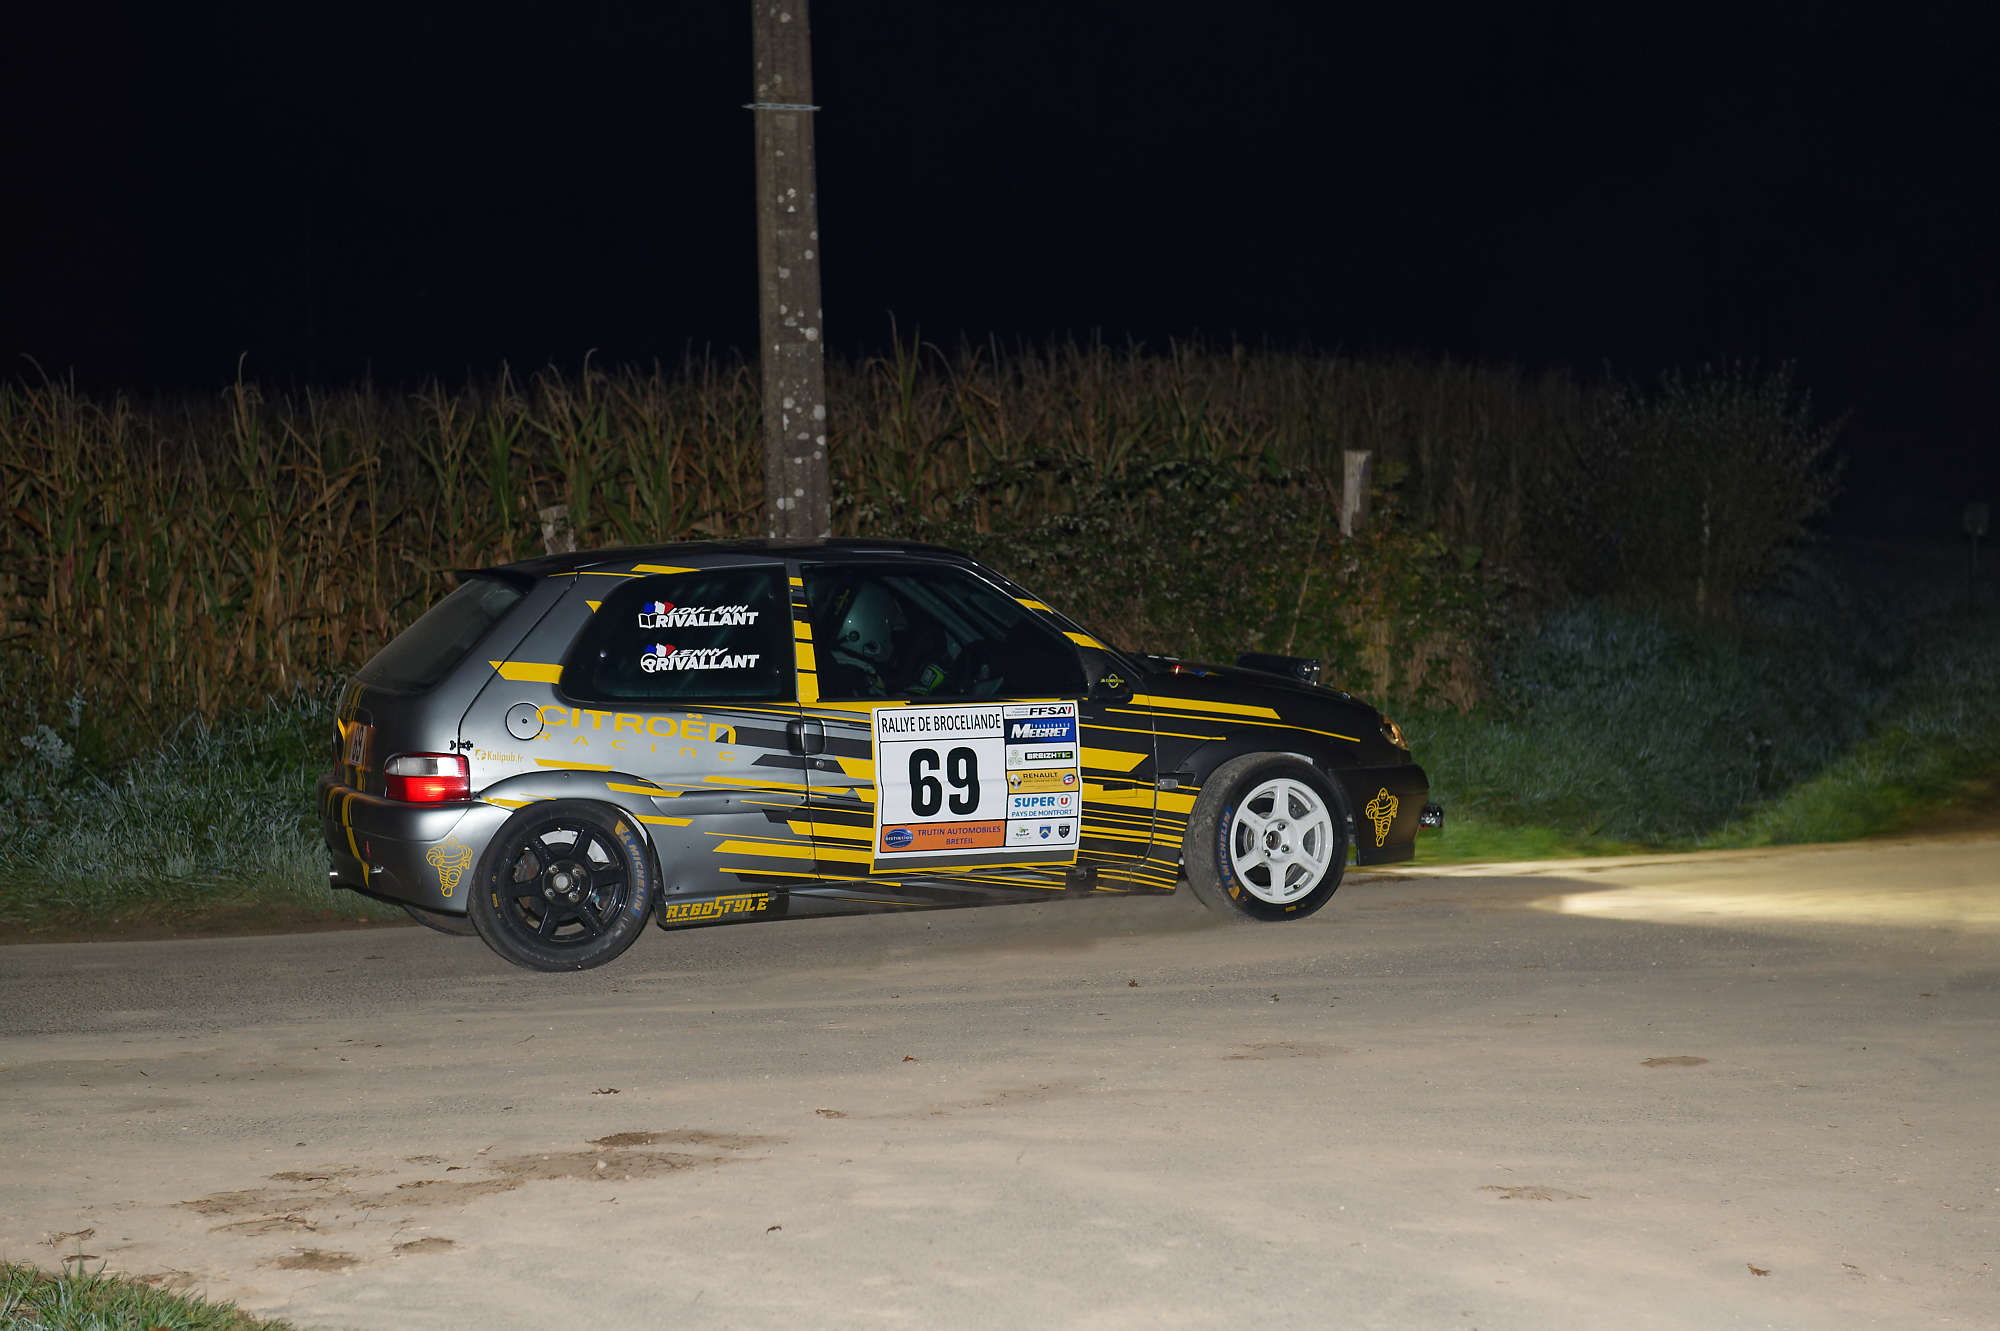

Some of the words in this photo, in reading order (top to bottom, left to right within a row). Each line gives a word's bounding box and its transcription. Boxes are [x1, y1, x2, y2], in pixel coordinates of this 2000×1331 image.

[668, 604, 748, 616] LOU-ANN
[655, 612, 759, 628] RIVALLANT
[668, 648, 728, 659] LENNY
[655, 654, 760, 671] RIVALLANT
[1029, 706, 1067, 716] FFSA
[536, 705, 737, 744] CITROËN
[881, 716, 916, 734] RALLYE
[919, 715, 932, 732] DE
[934, 713, 1001, 732] BROCELIANDE
[1011, 723, 1070, 739] MEGRET
[534, 731, 736, 763] RACING
[908, 746, 981, 817] 69
[1014, 796, 1056, 808] SUPER
[1038, 809, 1072, 817] MONTFORT
[918, 829, 945, 837] TRUTIN
[946, 825, 1001, 836] AUTOMOBILES
[945, 837, 974, 845] BRETEIL
[1220, 811, 1231, 876] MICHELIN
[629, 843, 646, 912] MICHELIN
